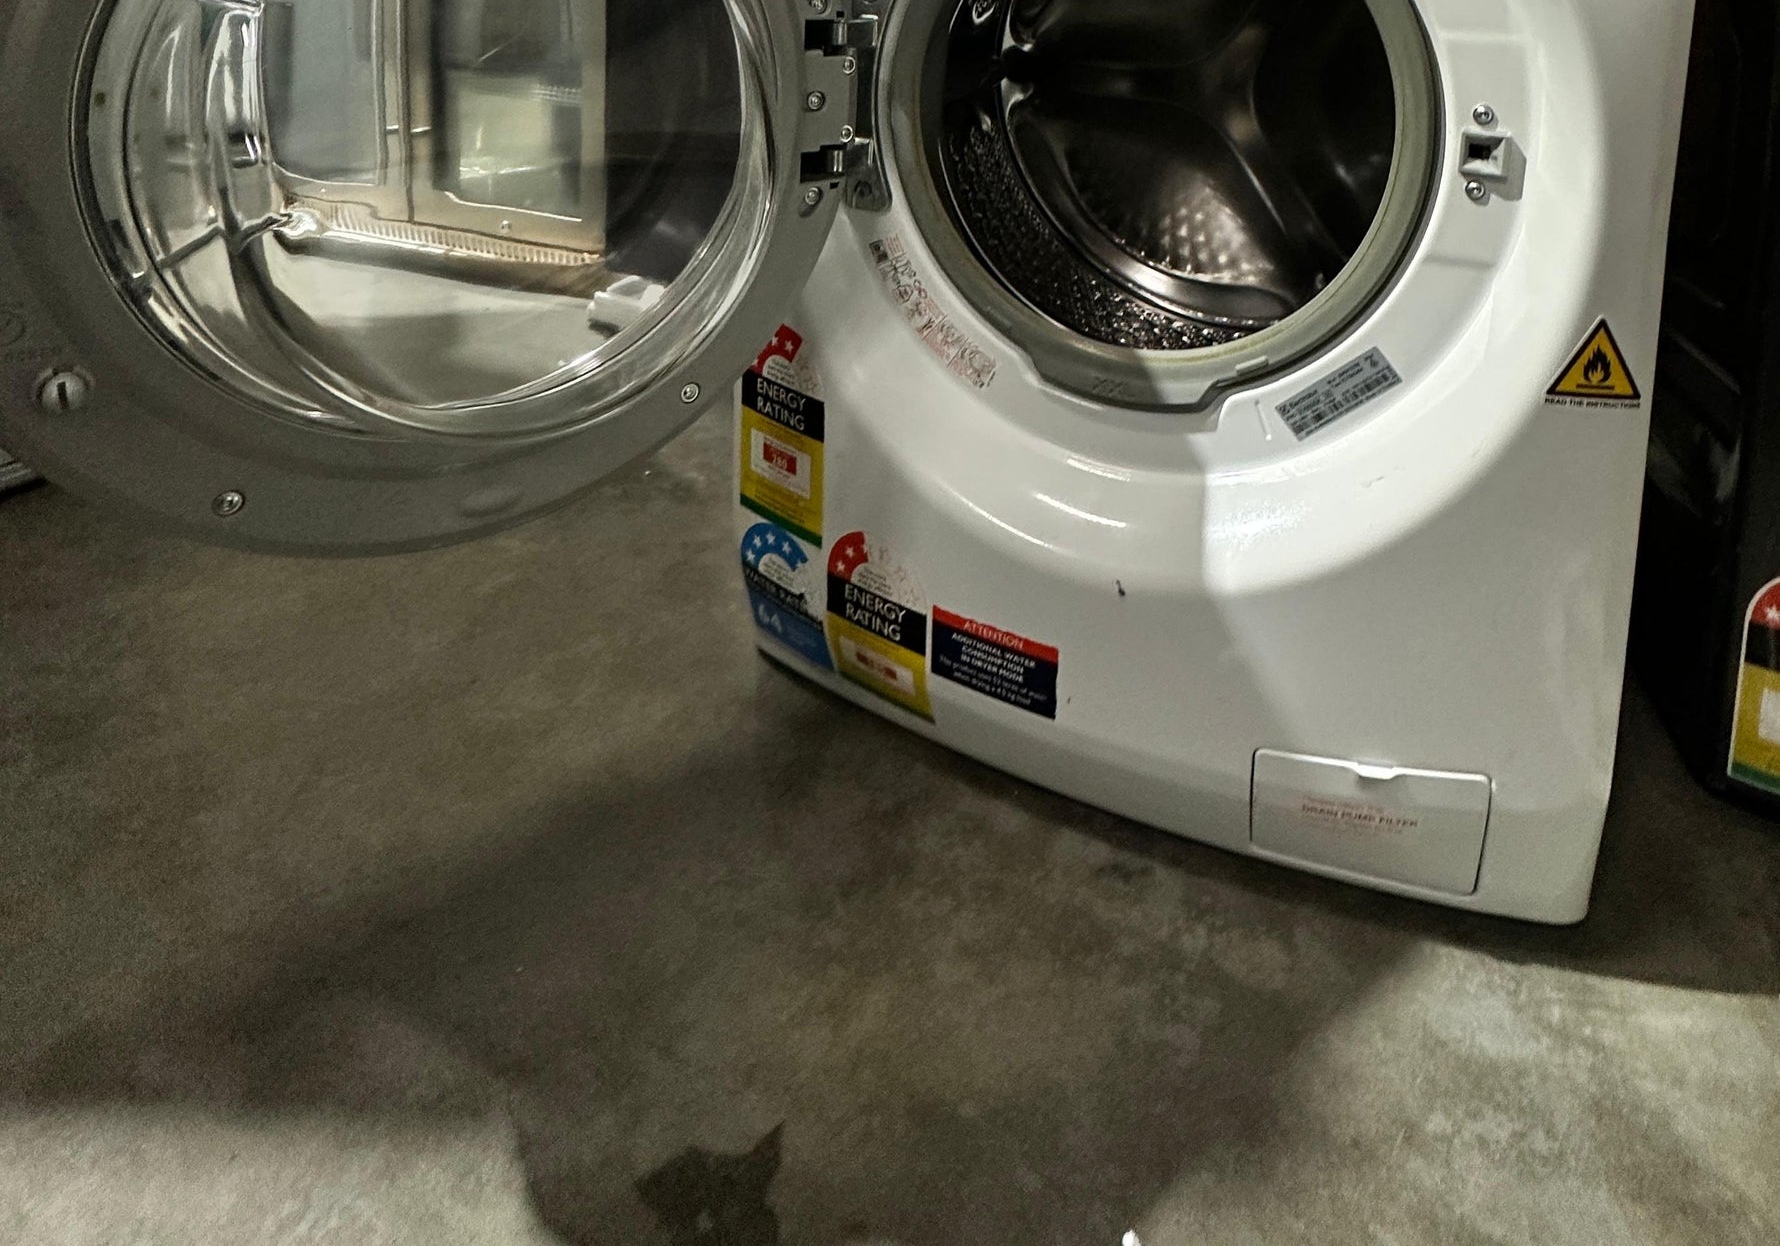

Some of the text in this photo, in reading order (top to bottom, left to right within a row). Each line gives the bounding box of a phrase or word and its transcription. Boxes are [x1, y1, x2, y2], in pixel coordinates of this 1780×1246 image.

[757, 377, 806, 412] ENERGY
[757, 396, 805, 432] RATING
[844, 583, 907, 622] ENERGY
[845, 603, 901, 641] RATING
[963, 620, 1024, 650] ATTENTION
[952, 633, 1036, 668] ADDITIONAL WATER
[1302, 804, 1338, 818] DRAIN
[1341, 812, 1376, 822] PUMP
[1379, 817, 1418, 827] FILTER
